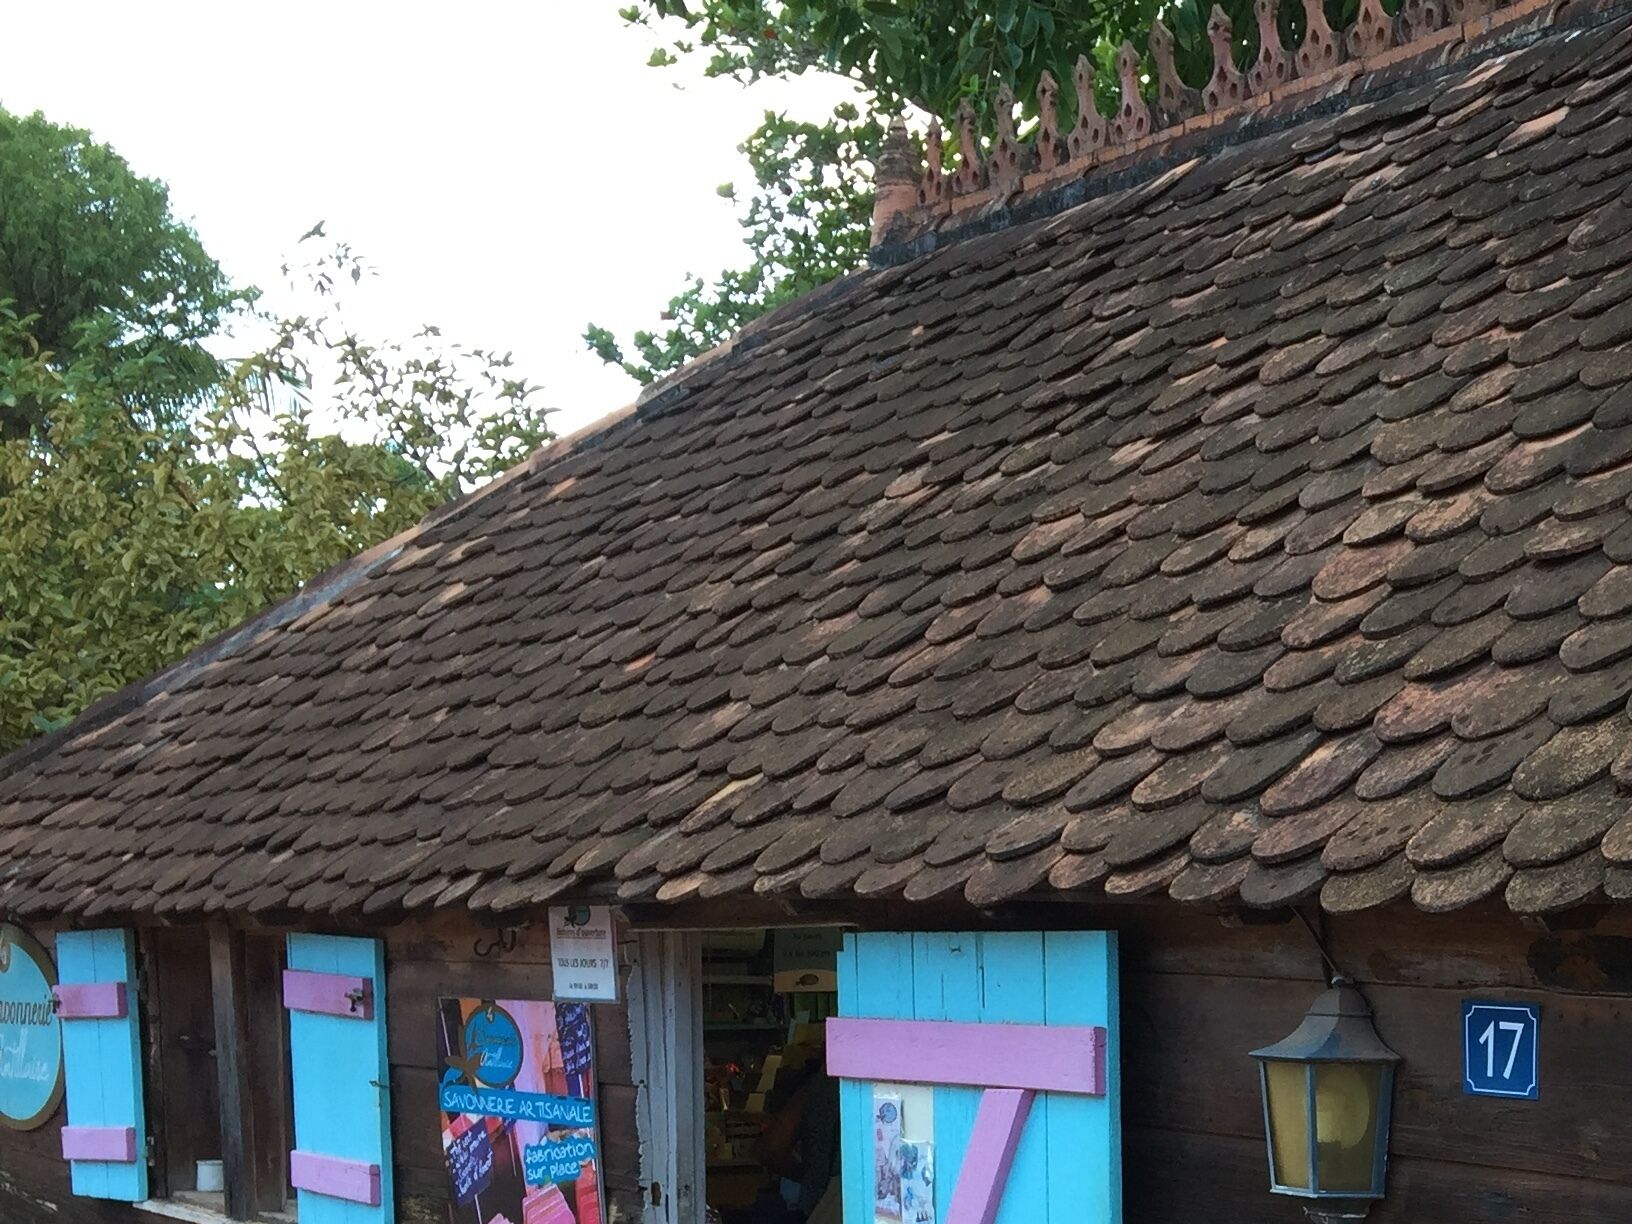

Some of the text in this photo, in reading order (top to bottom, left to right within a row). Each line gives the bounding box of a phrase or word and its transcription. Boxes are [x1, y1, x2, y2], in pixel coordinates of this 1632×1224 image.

[1478, 1020, 1525, 1080] 17
[519, 1100, 593, 1123] ARTISANALE
[526, 1142, 595, 1165] fabrication
[527, 1161, 579, 1181] sur place
